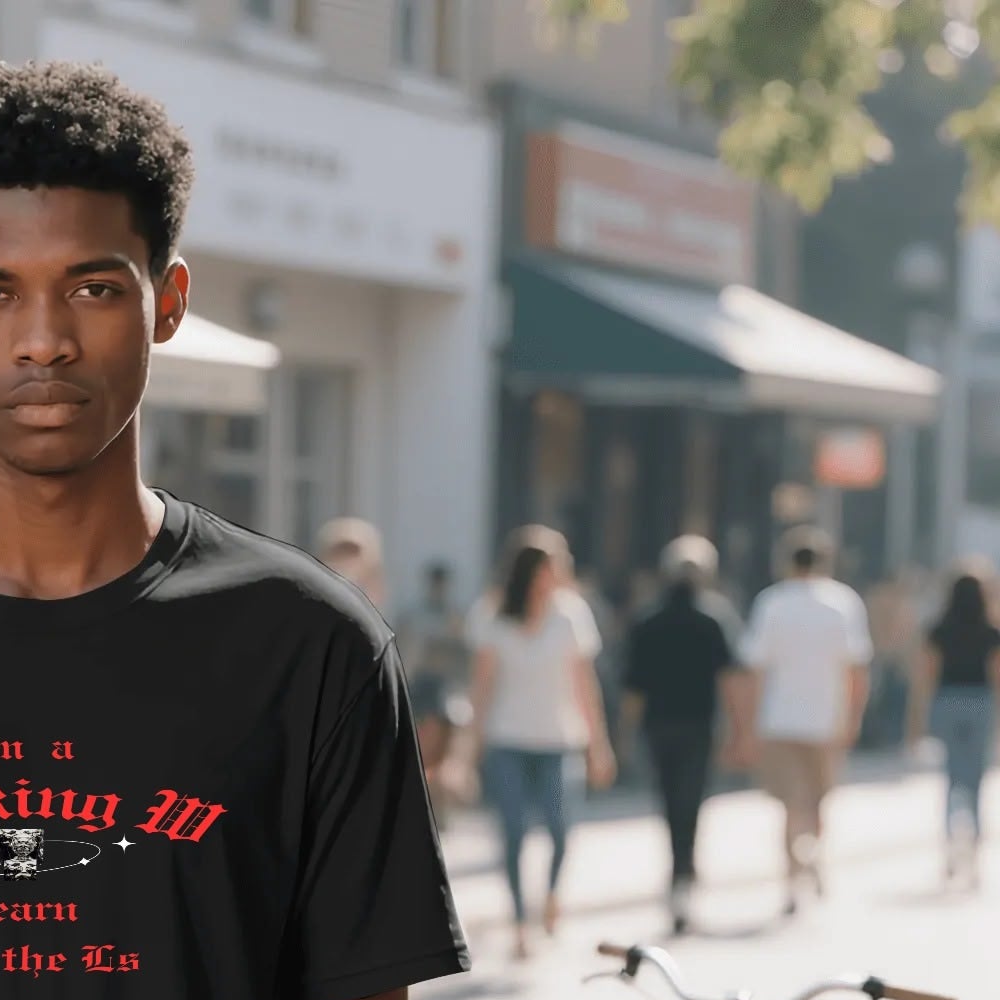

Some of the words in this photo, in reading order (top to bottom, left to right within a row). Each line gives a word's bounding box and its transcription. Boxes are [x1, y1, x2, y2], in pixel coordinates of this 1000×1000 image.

[51, 740, 75, 760] a
[134, 789, 229, 843] W
[1, 944, 67, 978] the
[81, 944, 140, 973] Ls
